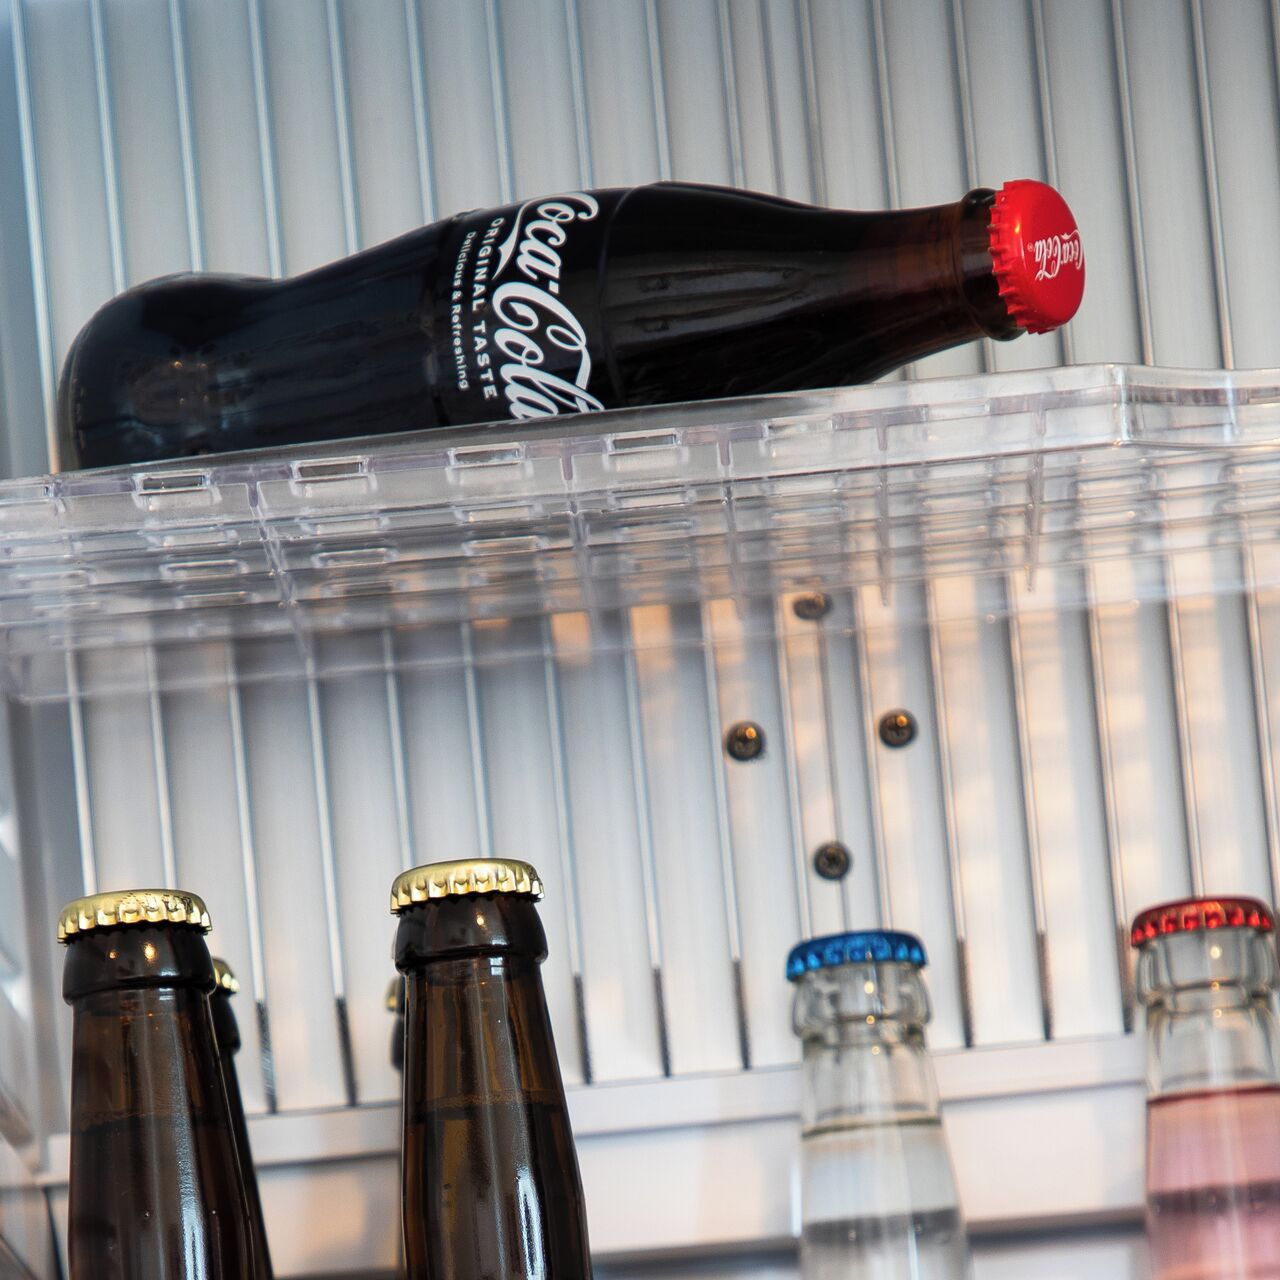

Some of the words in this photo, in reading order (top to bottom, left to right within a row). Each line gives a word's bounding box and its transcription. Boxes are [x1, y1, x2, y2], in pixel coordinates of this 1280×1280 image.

[451, 231, 477, 287] Delicious
[452, 290, 463, 302] &
[471, 217, 505, 312] ORIGINAL
[450, 304, 470, 391] Refreshing
[491, 192, 606, 420] Coca-Cola
[472, 320, 498, 400] TASTE
